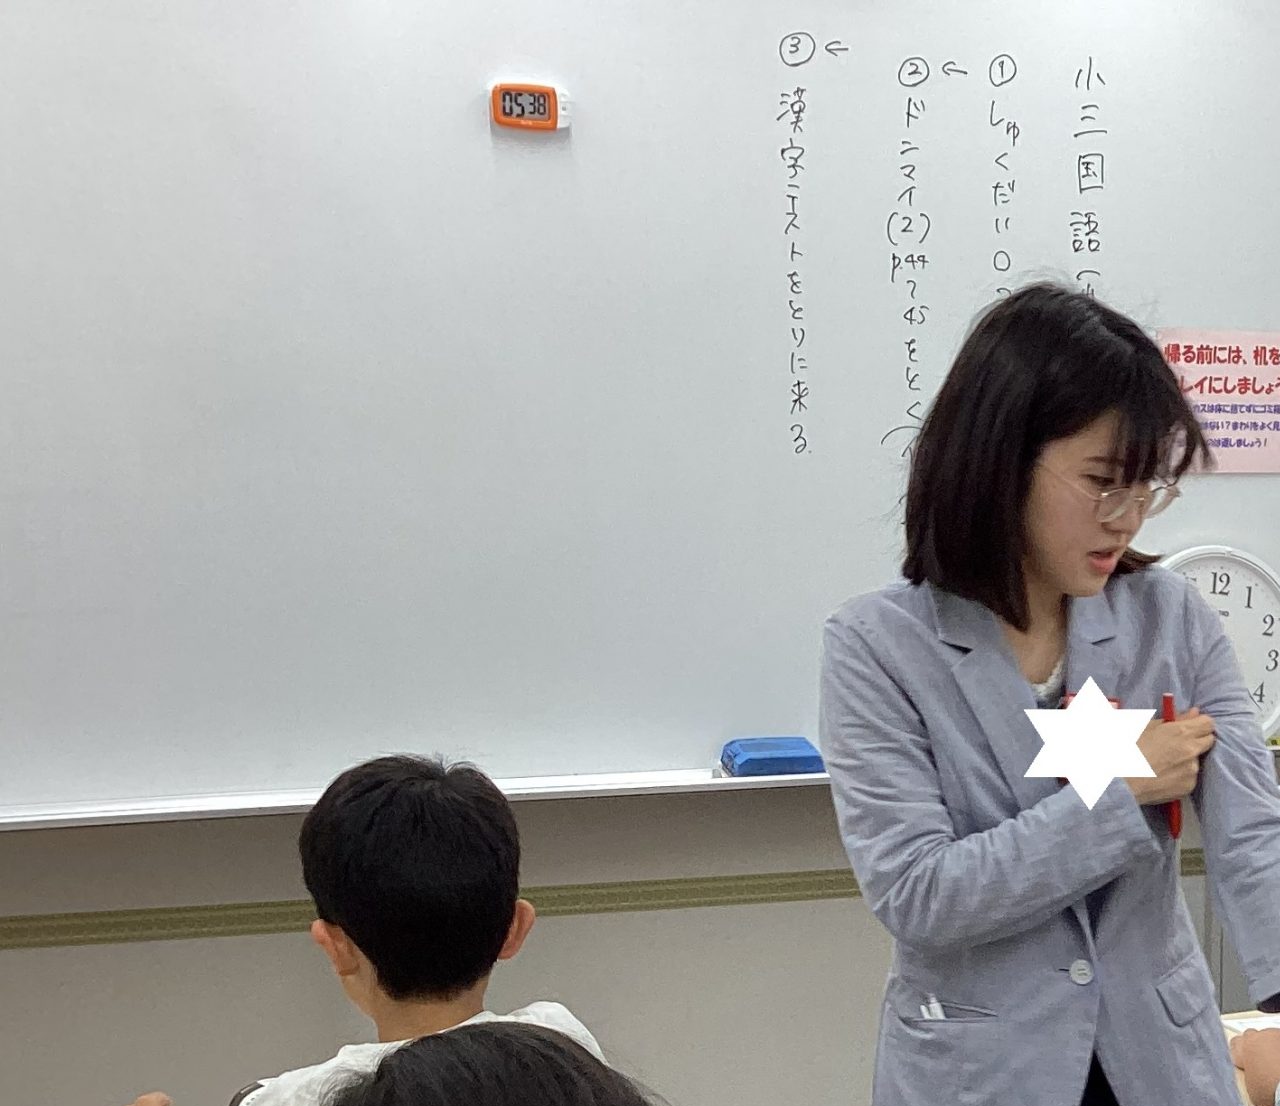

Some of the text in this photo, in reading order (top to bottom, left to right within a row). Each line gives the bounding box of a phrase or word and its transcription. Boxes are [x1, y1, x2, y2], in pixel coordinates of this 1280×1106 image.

[1209, 571, 1231, 596] 12
[1244, 585, 1253, 609] 1
[1262, 614, 1275, 637] 2
[1265, 649, 1280, 672] 3
[1252, 682, 1265, 703] 4
